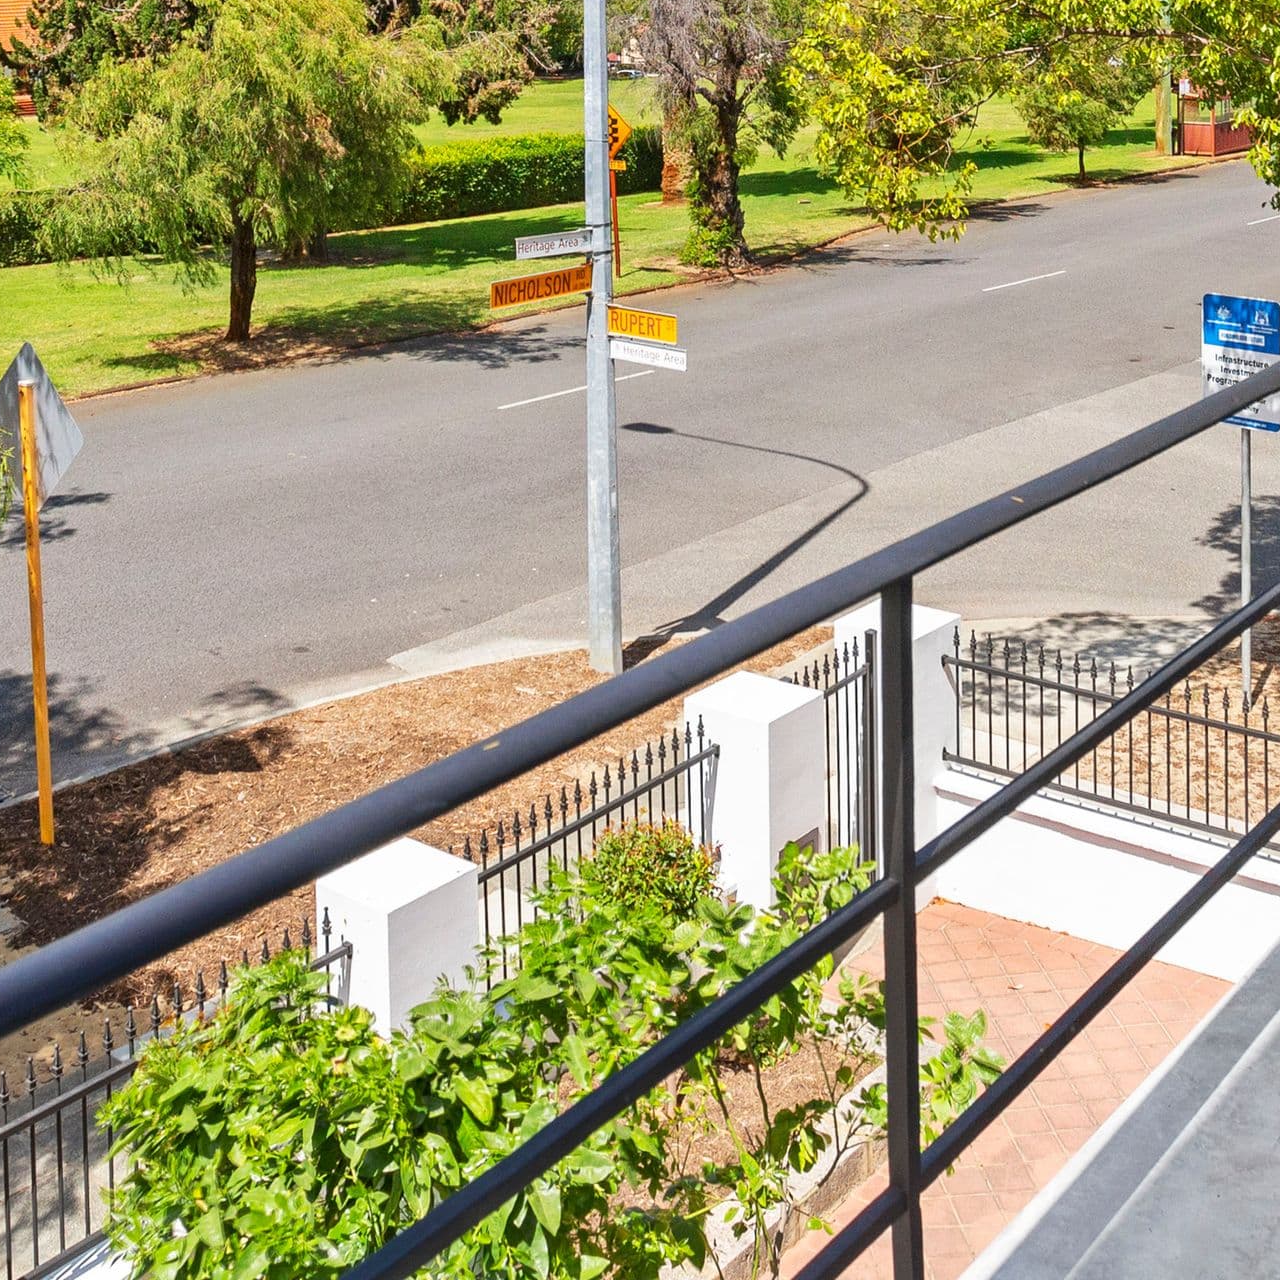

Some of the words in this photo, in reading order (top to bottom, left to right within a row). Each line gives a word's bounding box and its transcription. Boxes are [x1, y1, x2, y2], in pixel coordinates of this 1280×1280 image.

[517, 240, 555, 254] Heritage
[559, 238, 579, 249] Area
[494, 271, 571, 306] NICHOLSON
[610, 311, 662, 336] RUPERT
[623, 345, 661, 363] Heritage
[664, 352, 685, 365] Area
[1215, 354, 1269, 368] Infrastructure
